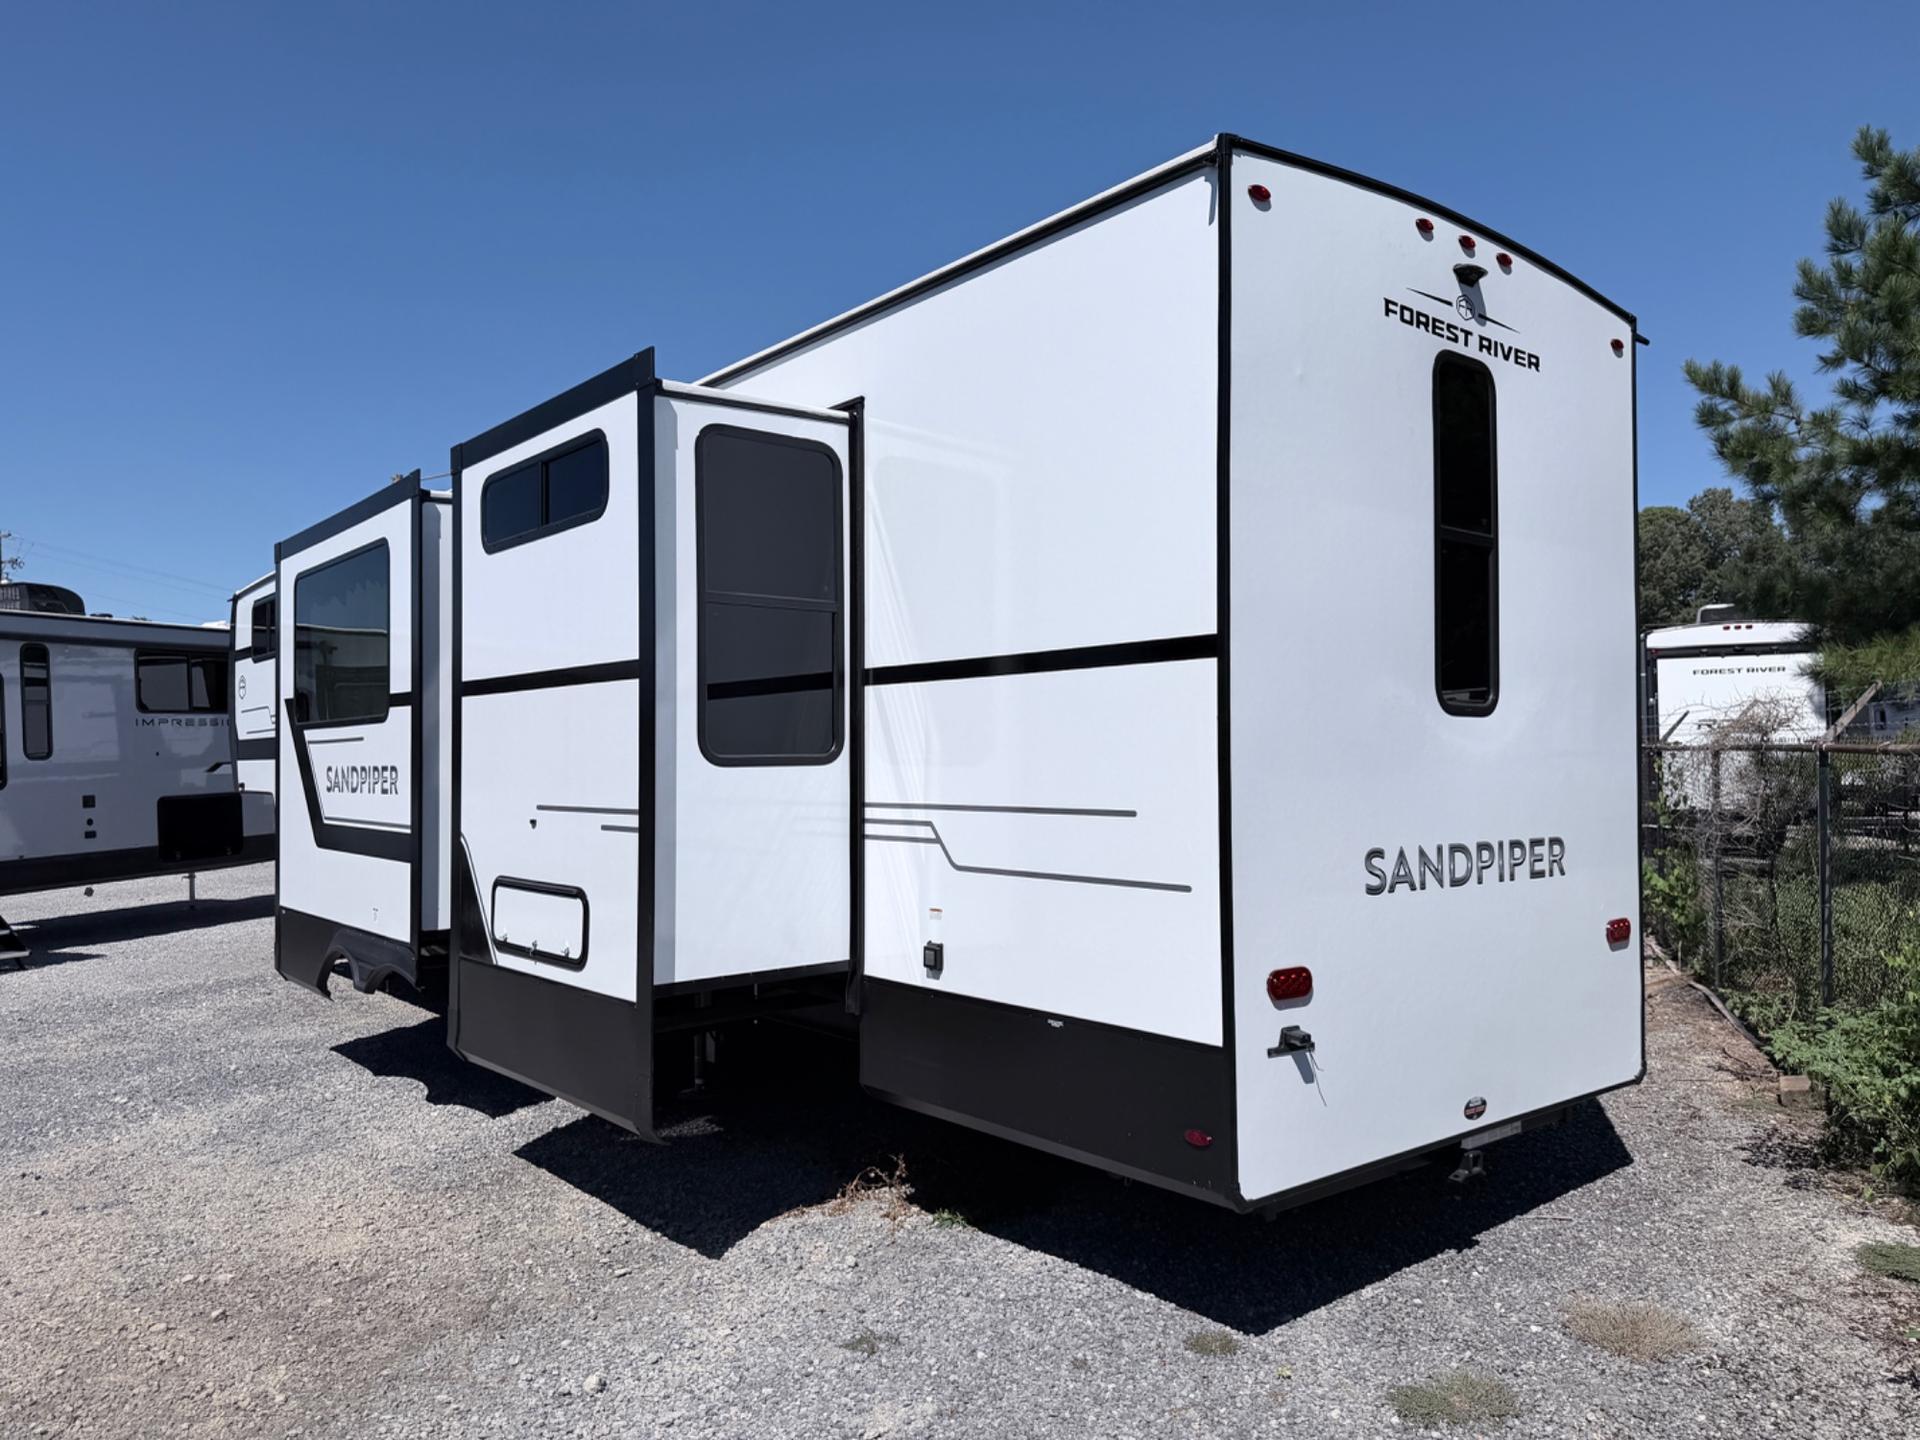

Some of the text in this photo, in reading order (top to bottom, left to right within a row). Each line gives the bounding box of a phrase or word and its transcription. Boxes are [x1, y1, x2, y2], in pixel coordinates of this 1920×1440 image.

[1383, 297, 1541, 372] FOREST RIVER
[1692, 667, 1743, 675] FOREST
[326, 765, 399, 795] SANDPIPER
[1364, 836, 1566, 896] SANDPIPER
